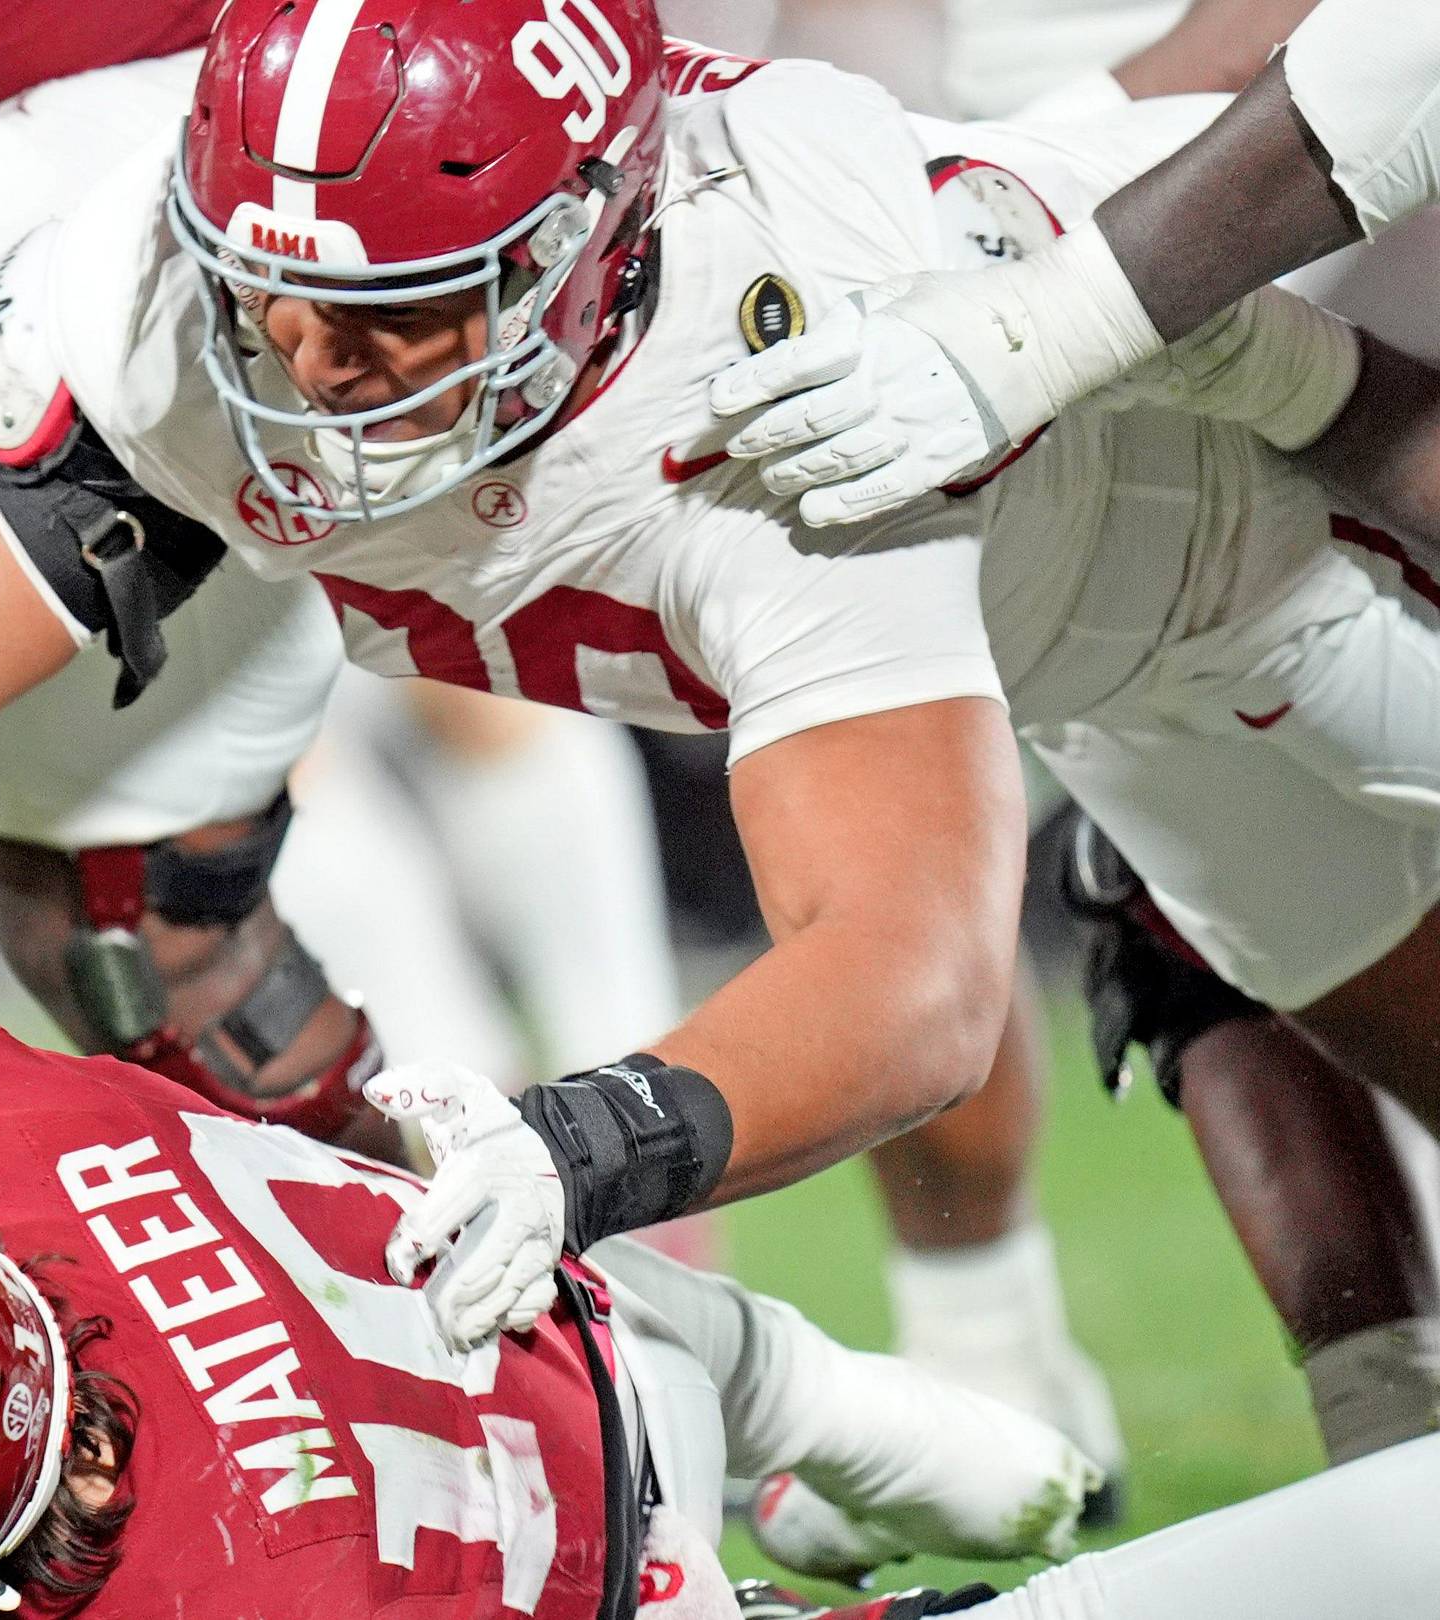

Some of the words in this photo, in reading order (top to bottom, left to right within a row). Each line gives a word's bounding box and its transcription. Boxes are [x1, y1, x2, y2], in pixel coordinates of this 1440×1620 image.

[511, 0, 631, 143] 90
[251, 222, 319, 262] BAMA
[56, 1136, 358, 1515] MATEER
[177, 1111, 558, 1617] 10
